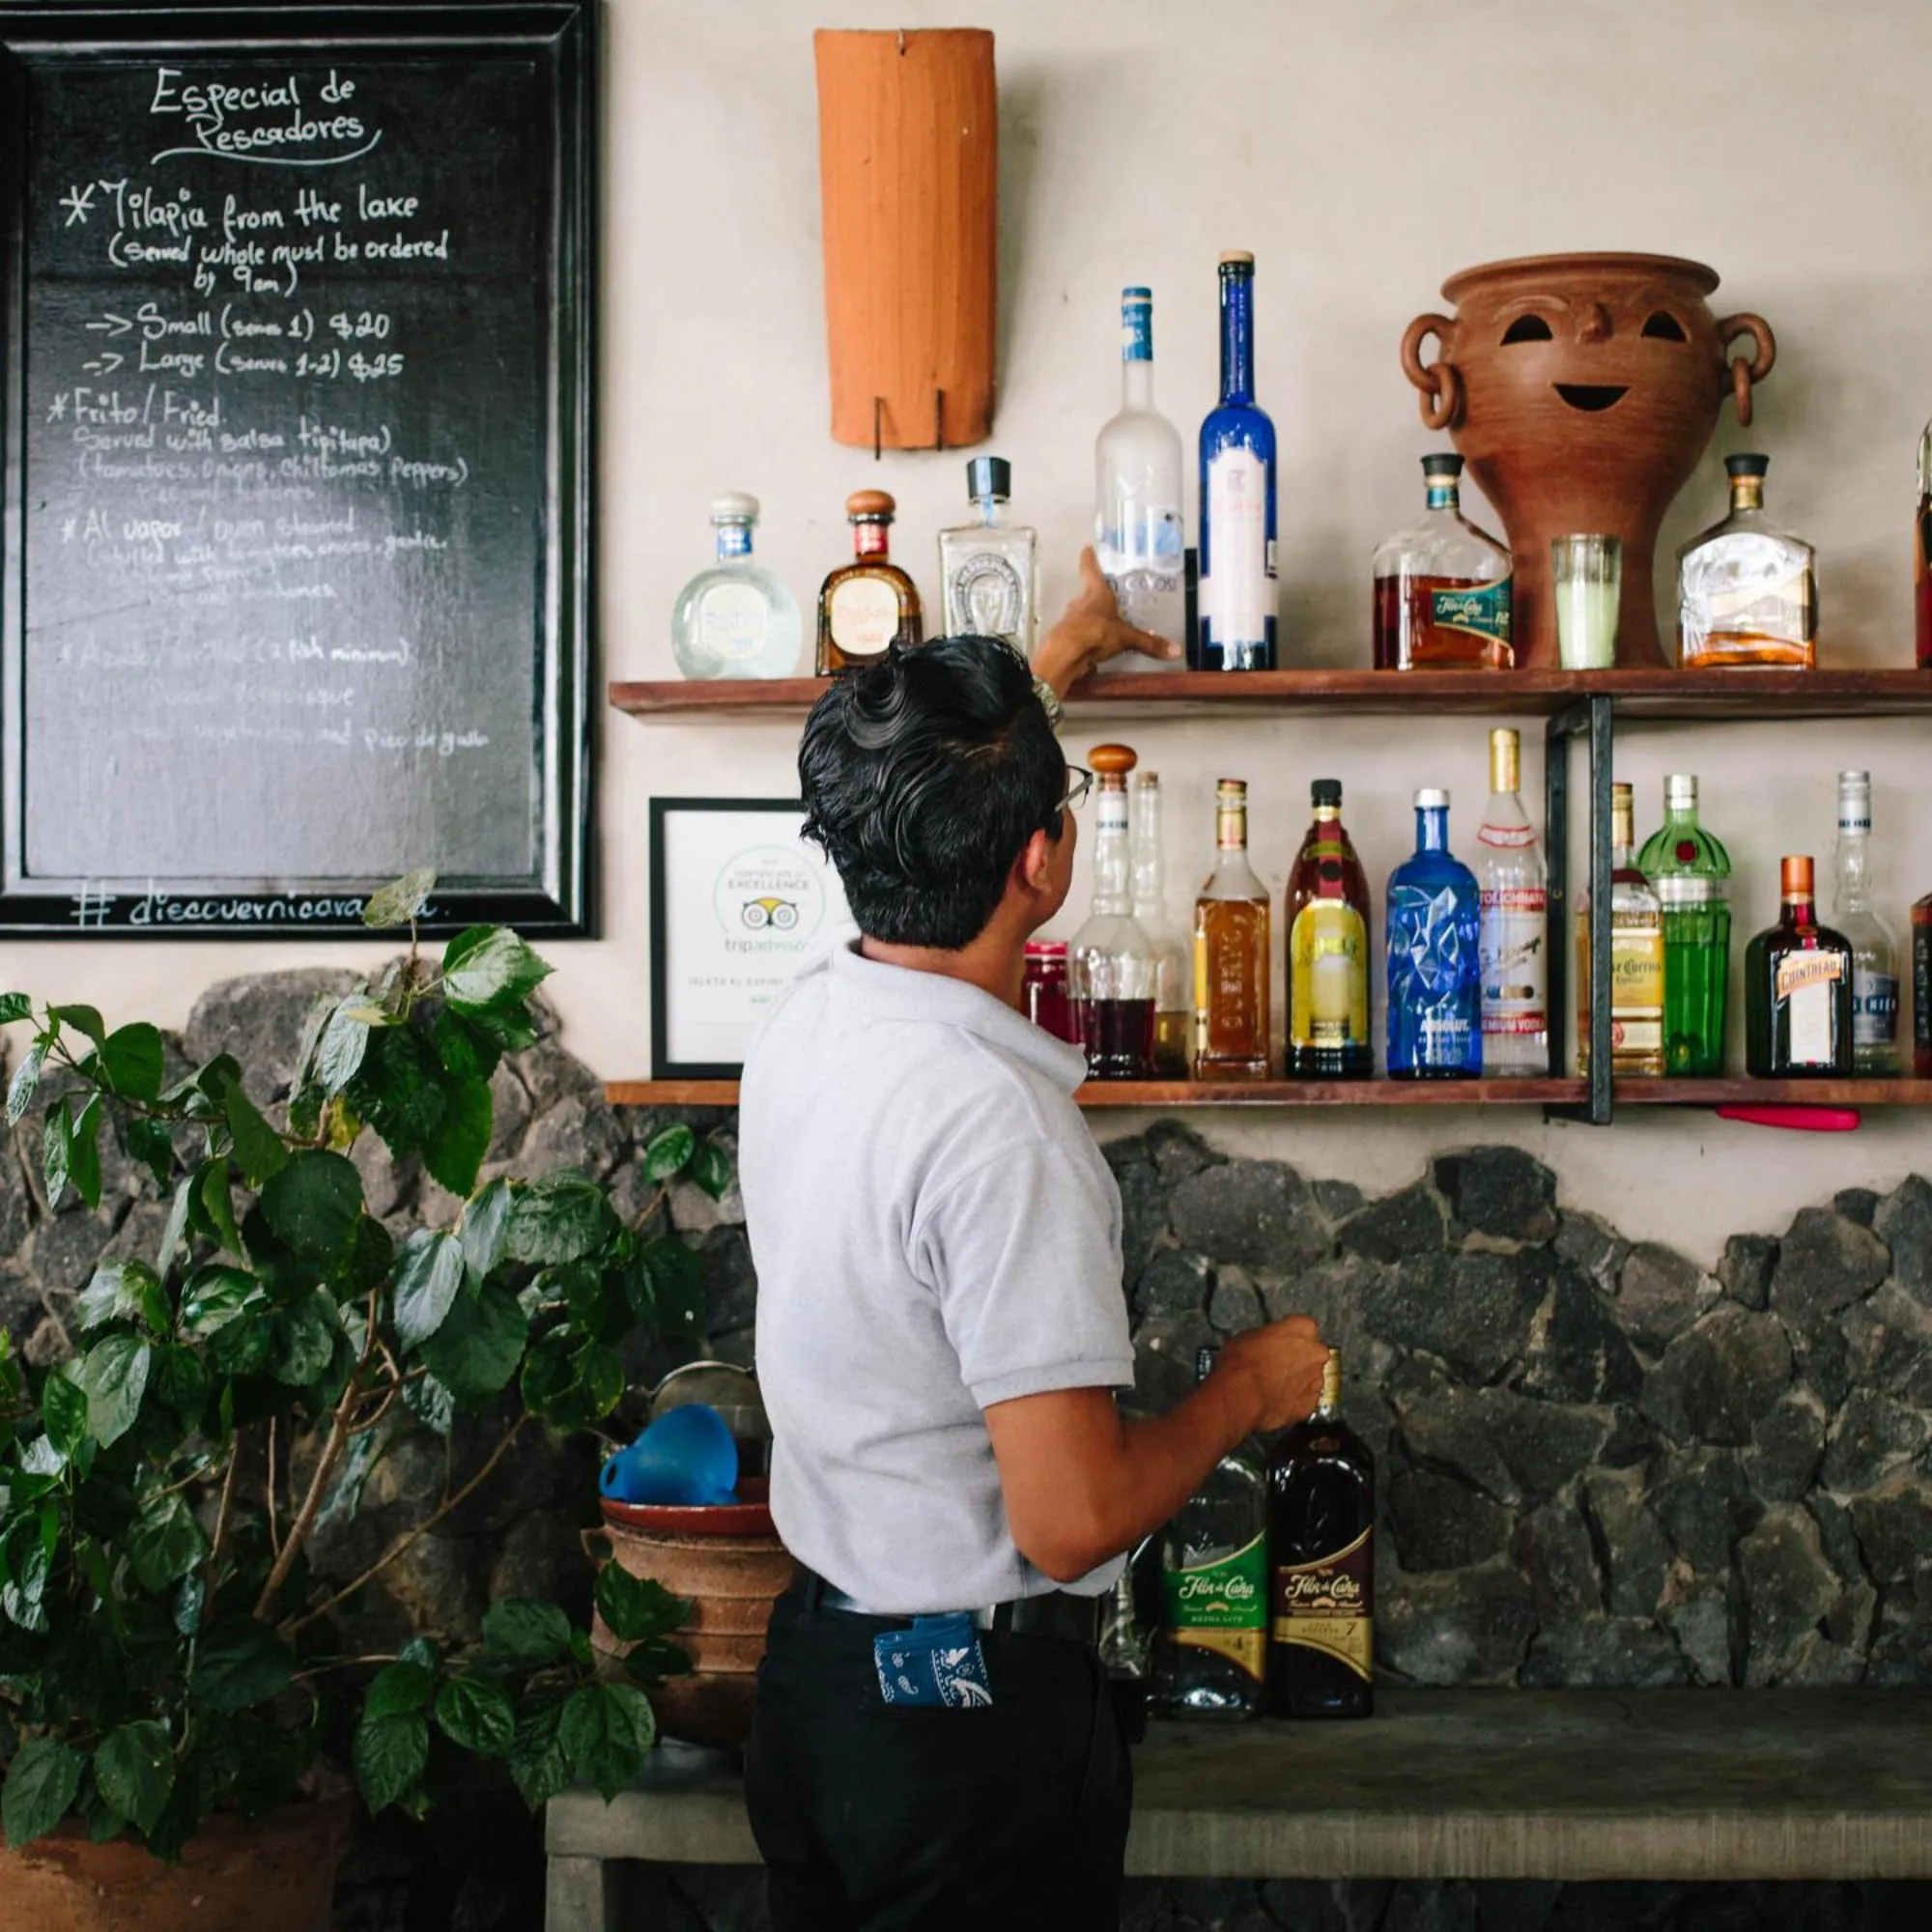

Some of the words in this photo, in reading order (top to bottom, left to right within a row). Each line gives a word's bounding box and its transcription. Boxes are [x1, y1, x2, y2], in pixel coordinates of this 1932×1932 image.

[151, 68, 300, 120] Especial
[320, 70, 355, 103] de
[185, 108, 364, 152] Pescadores
[99, 179, 209, 238] Tilapia
[223, 194, 285, 243] from
[294, 188, 341, 227] the
[359, 184, 419, 221] lake
[201, 241, 265, 265] whole
[272, 235, 325, 263] must
[334, 231, 358, 261] be
[365, 229, 449, 260] ordered
[136, 302, 212, 339] Small
[328, 311, 389, 340] $20
[139, 340, 205, 378] Large
